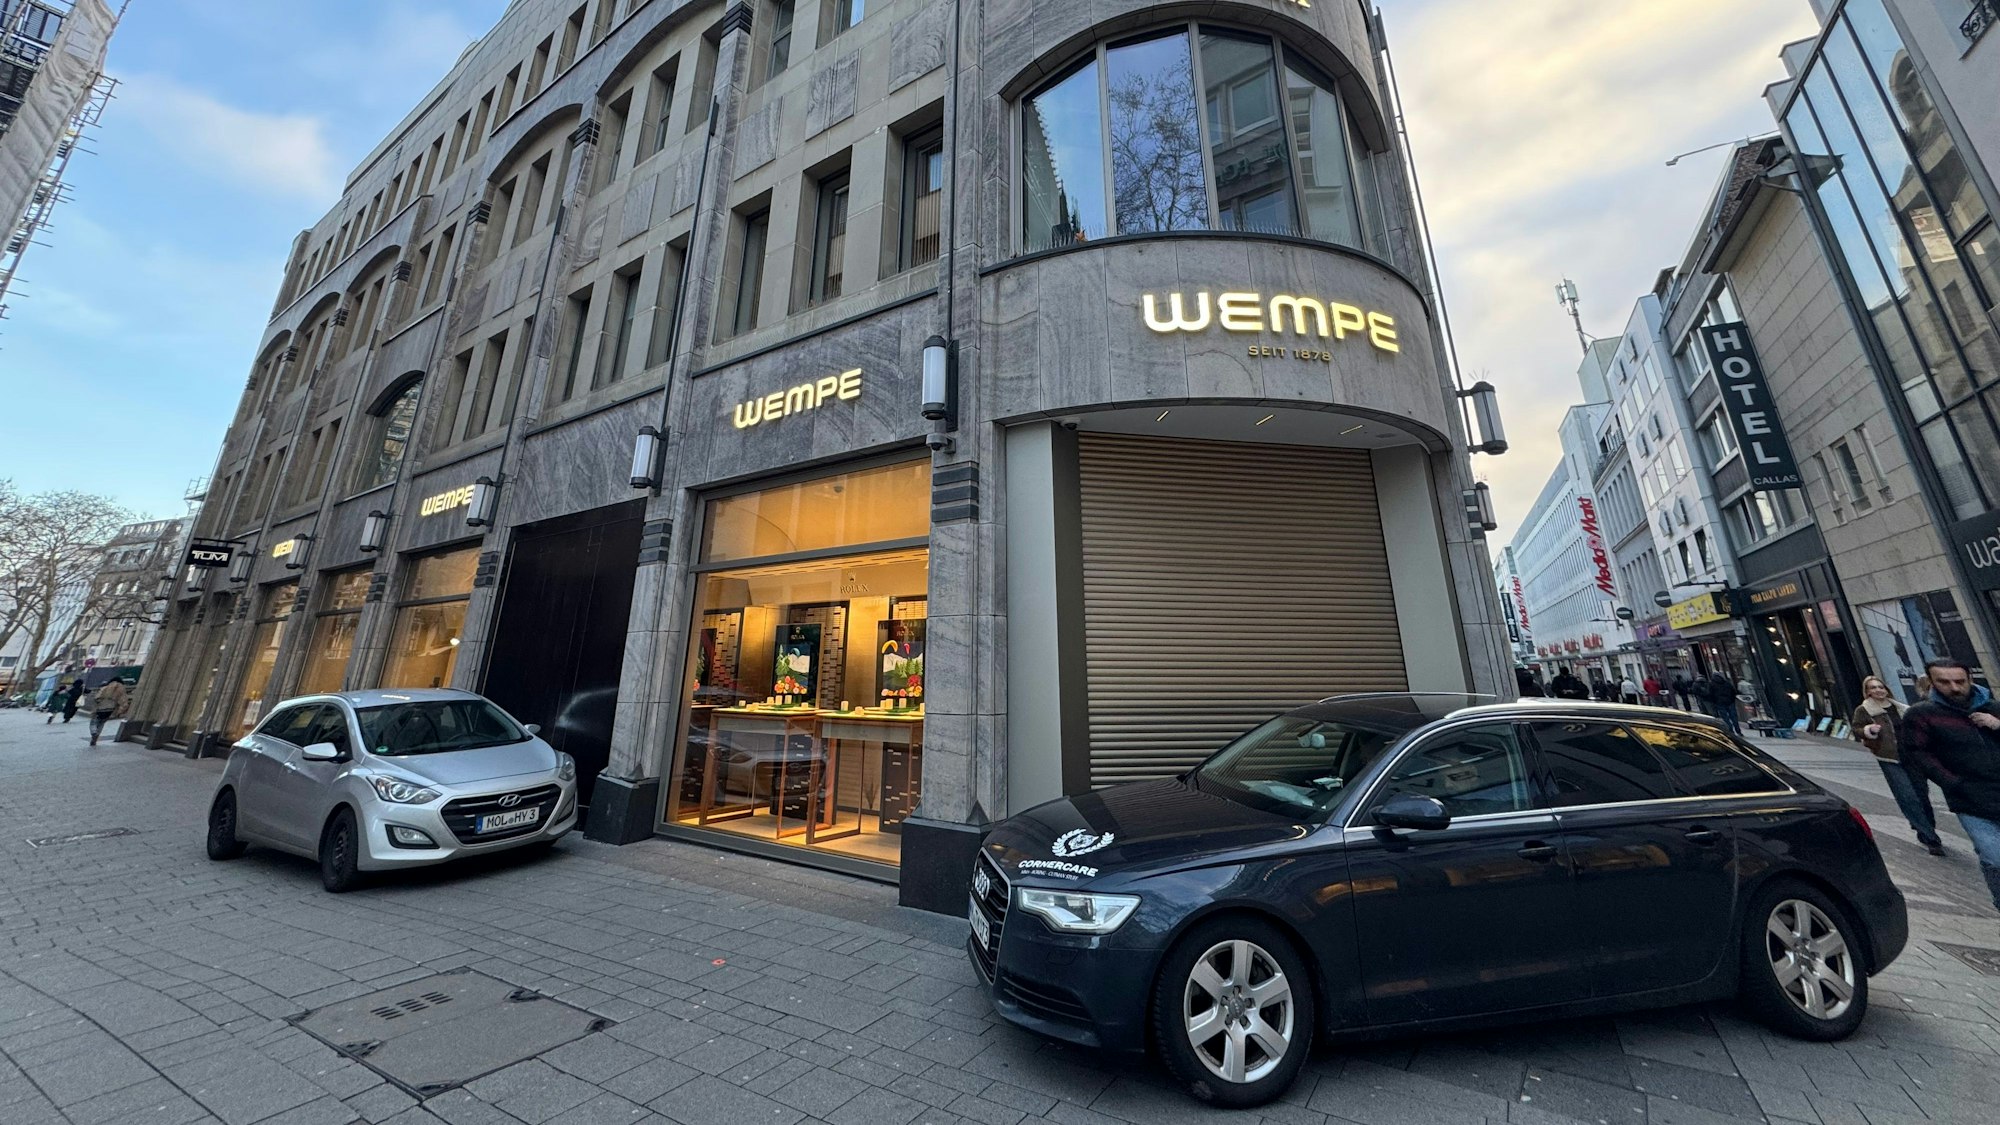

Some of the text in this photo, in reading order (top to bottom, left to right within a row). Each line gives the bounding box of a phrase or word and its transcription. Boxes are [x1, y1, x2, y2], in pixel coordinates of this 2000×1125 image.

[1142, 291, 1400, 353] WEMPE
[1248, 345, 1333, 362] SEIT 1878
[734, 367, 863, 429] WEMPE
[1712, 329, 1781, 465] HOTEL
[1753, 474, 1798, 486] CALLAS
[421, 484, 476, 516] WEMPE
[192, 550, 229, 562] TUMI
[1965, 526, 2000, 569] wa
[486, 808, 536, 828] MOL HY 3
[1018, 860, 1099, 877] CORNERCARE
